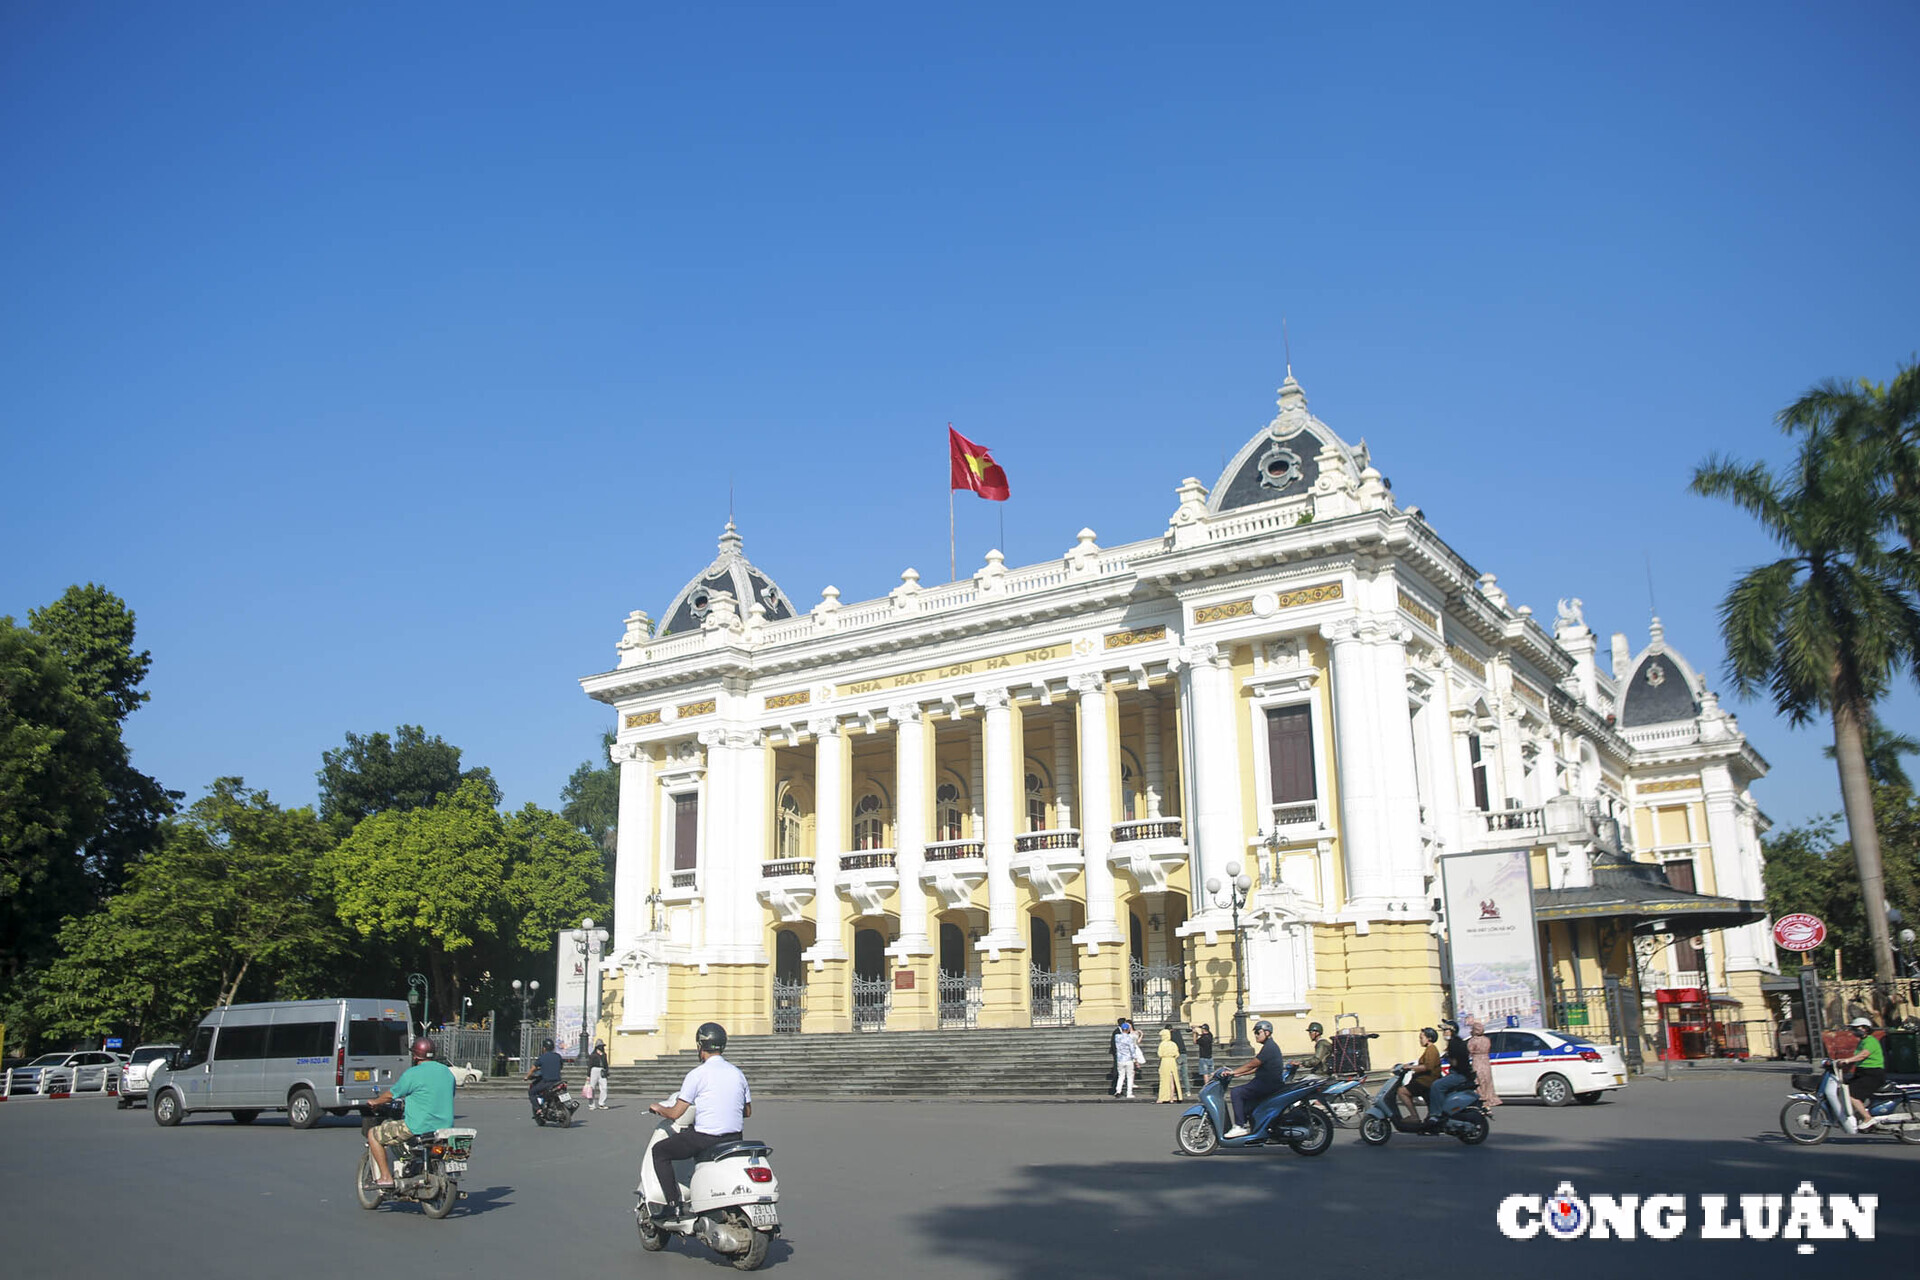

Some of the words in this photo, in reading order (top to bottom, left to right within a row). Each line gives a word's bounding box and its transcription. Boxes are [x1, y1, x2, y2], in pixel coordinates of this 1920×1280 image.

[987, 656, 1011, 670] HÀ
[1776, 916, 1821, 931] HIGHLANDS
[1783, 938, 1818, 949] COFFEE
